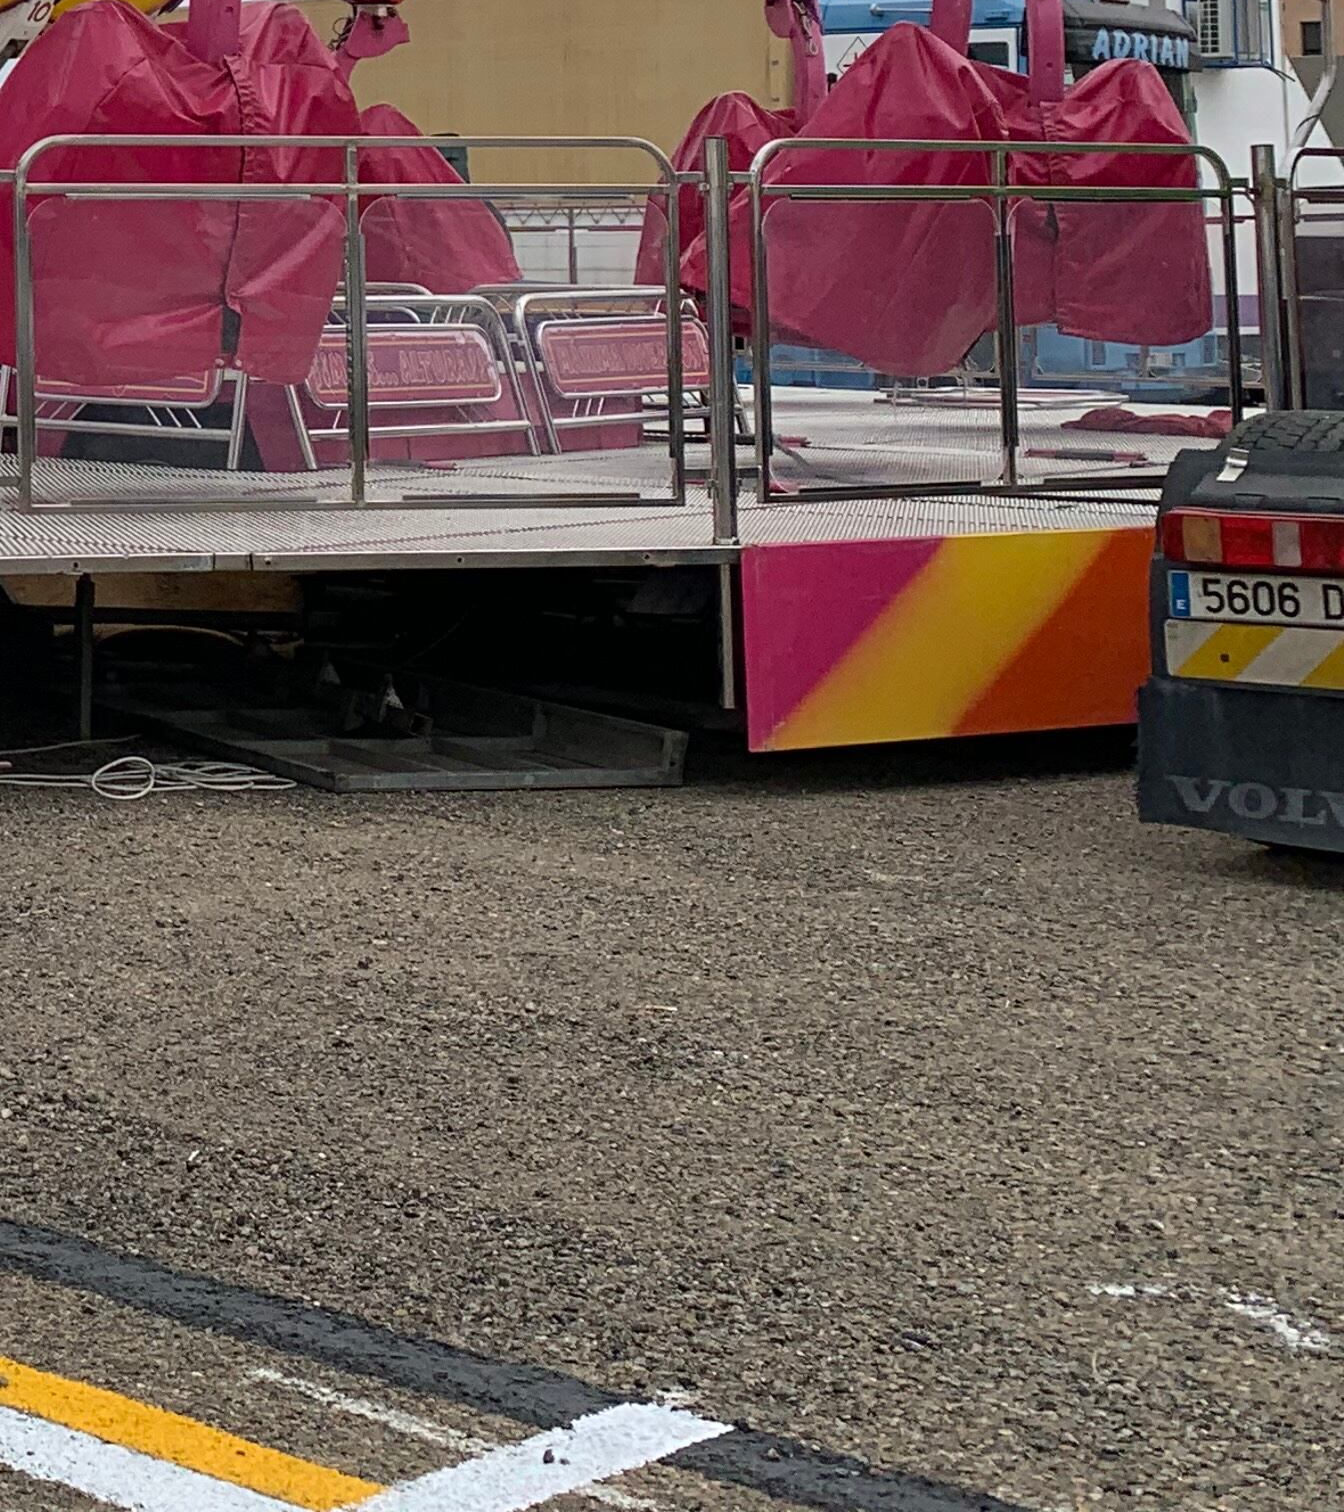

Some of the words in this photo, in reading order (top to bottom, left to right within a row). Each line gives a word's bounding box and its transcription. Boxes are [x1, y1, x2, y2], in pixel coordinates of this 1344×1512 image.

[26, 0, 52, 23] 10
[1091, 26, 1190, 69] ADRIAN
[1175, 598, 1187, 611] E
[1201, 577, 1301, 618] 5606
